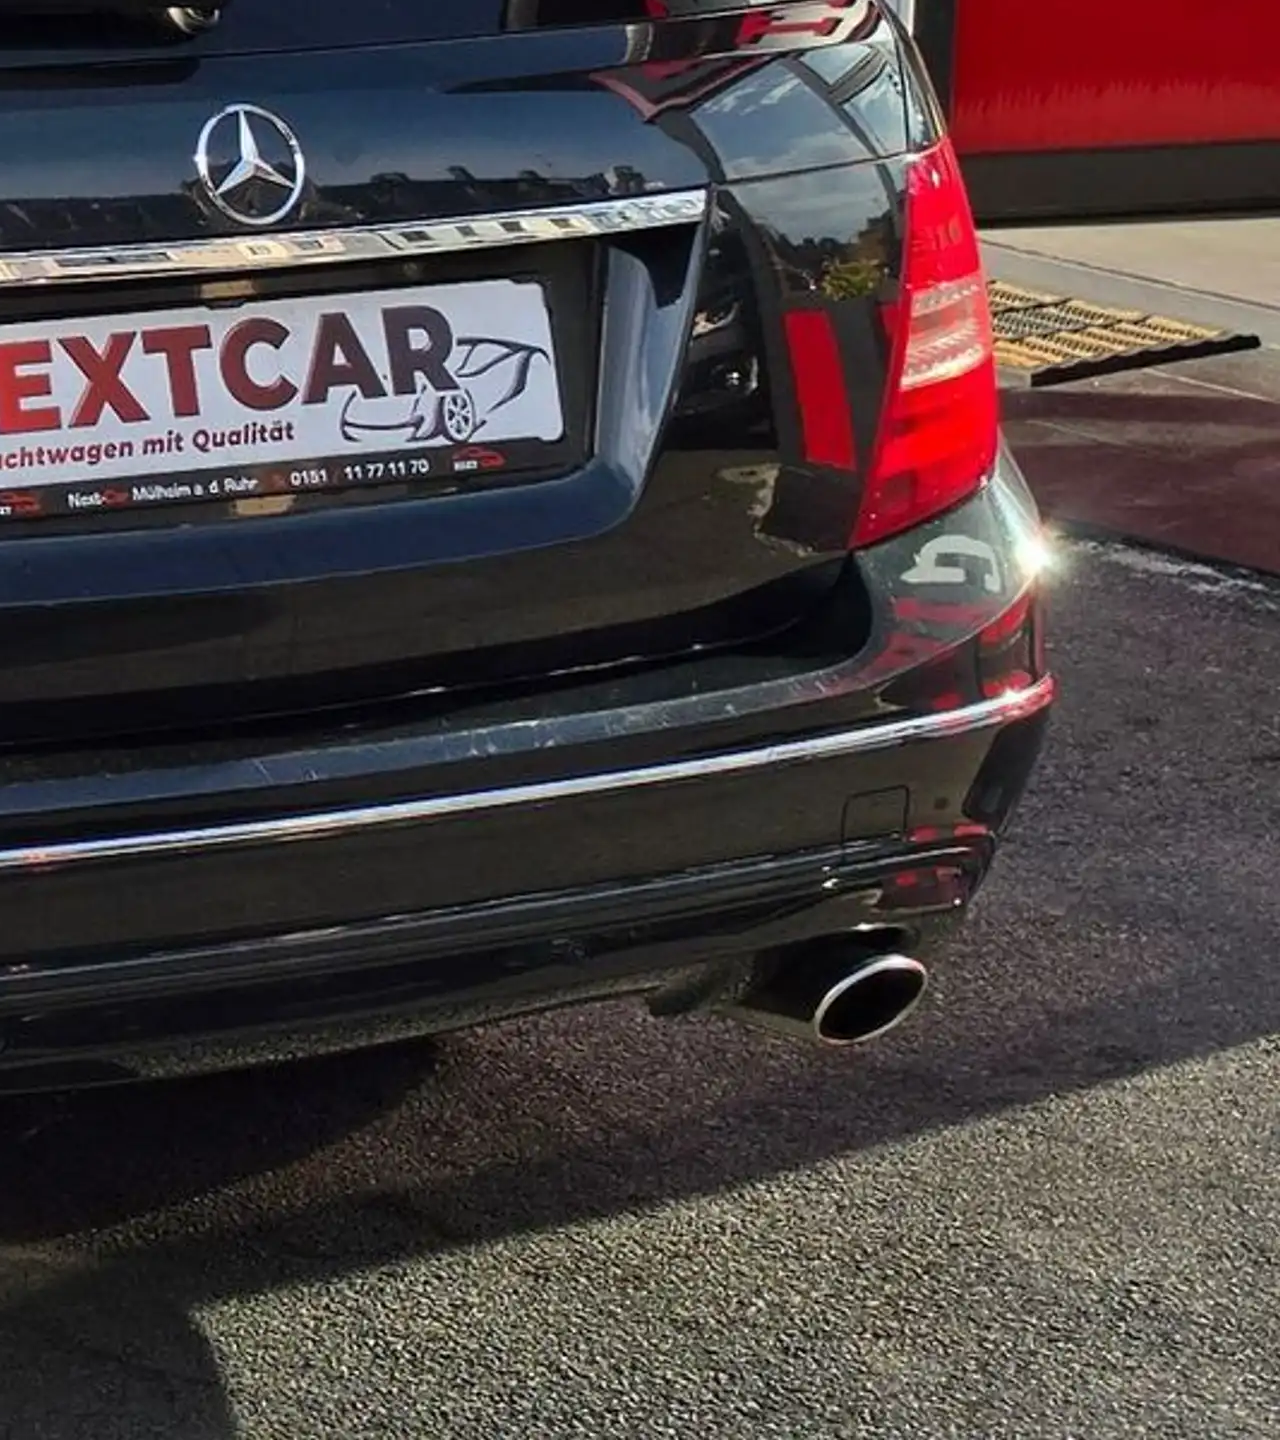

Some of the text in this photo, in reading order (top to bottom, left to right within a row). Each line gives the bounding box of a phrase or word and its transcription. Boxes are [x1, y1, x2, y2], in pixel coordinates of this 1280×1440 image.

[141, 429, 186, 458] mit
[192, 420, 296, 453] Qualität
[290, 468, 327, 486] 0151
